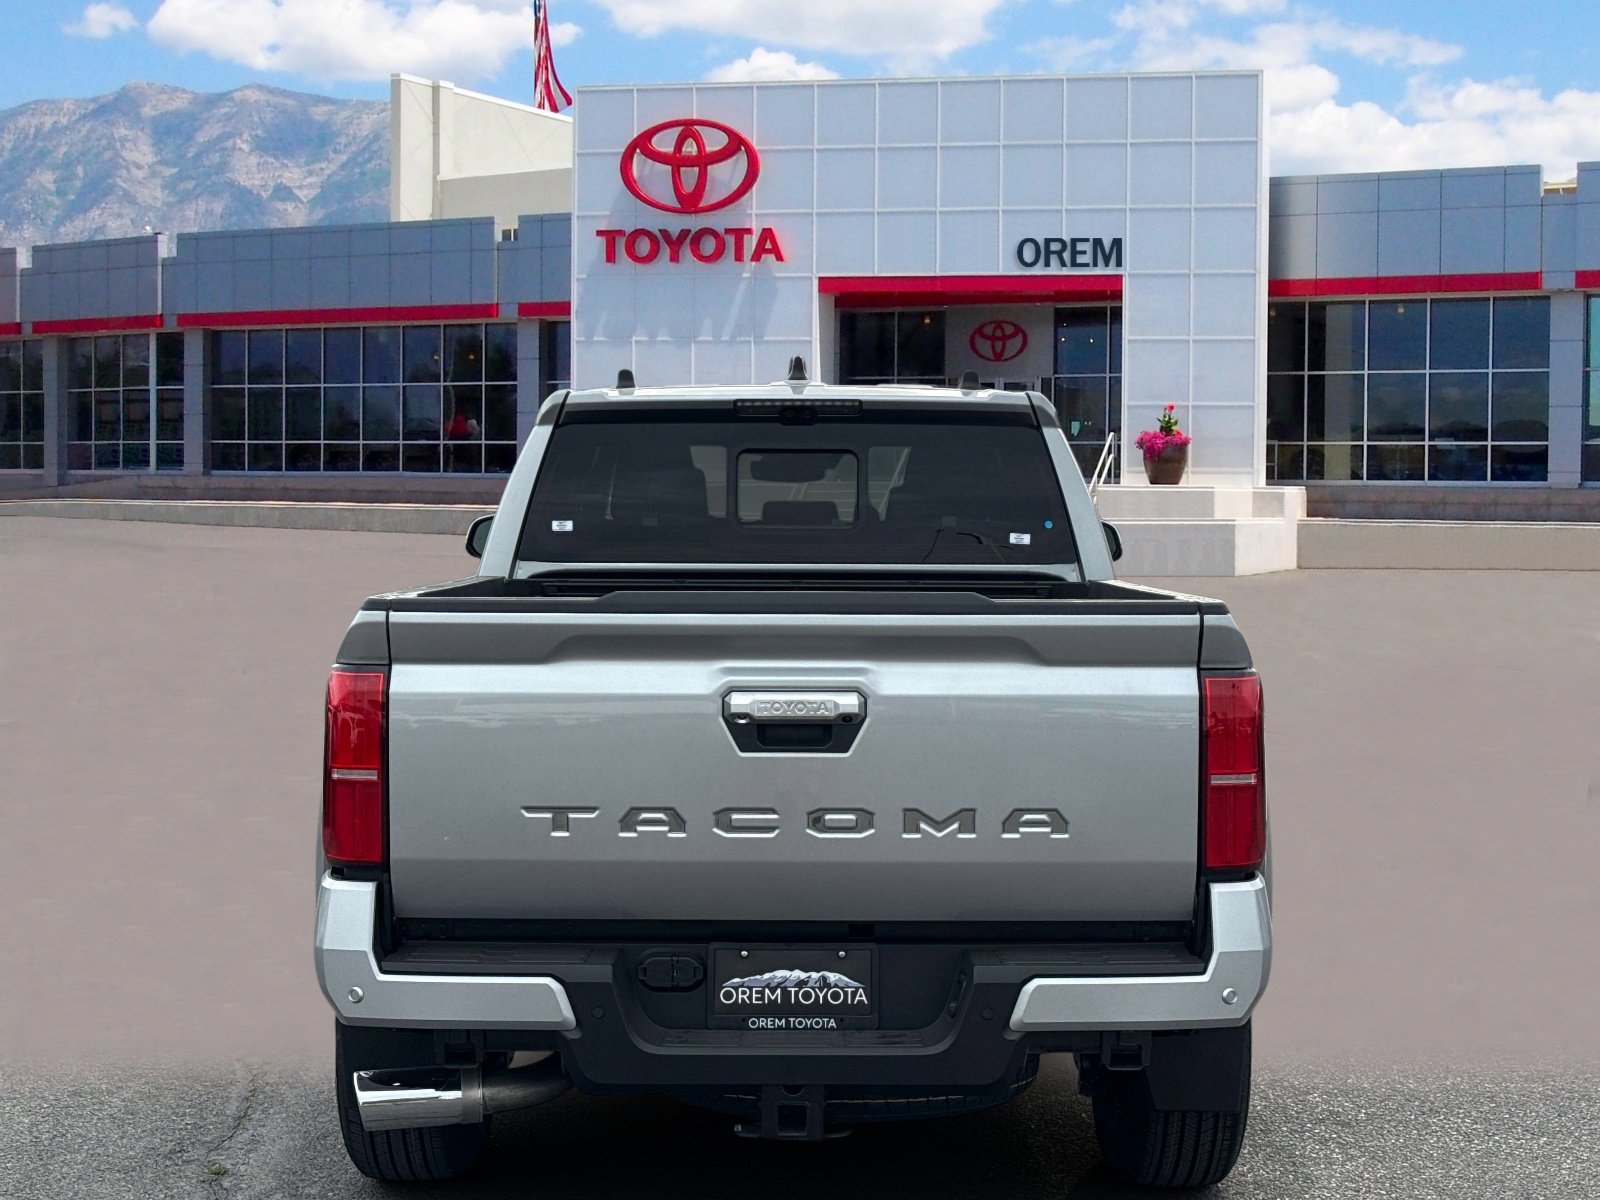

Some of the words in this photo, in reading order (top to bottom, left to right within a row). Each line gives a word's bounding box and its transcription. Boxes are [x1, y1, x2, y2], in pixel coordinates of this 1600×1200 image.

[596, 227, 785, 264] TOYOTA
[1016, 237, 1123, 268] OREM
[760, 701, 830, 716] TOYOTA
[521, 806, 1070, 838] TACOMA
[719, 987, 781, 1004] OREM
[786, 987, 868, 1004] TOYOTA
[748, 1017, 786, 1029] OREM
[788, 1017, 837, 1029] TOYOTA
